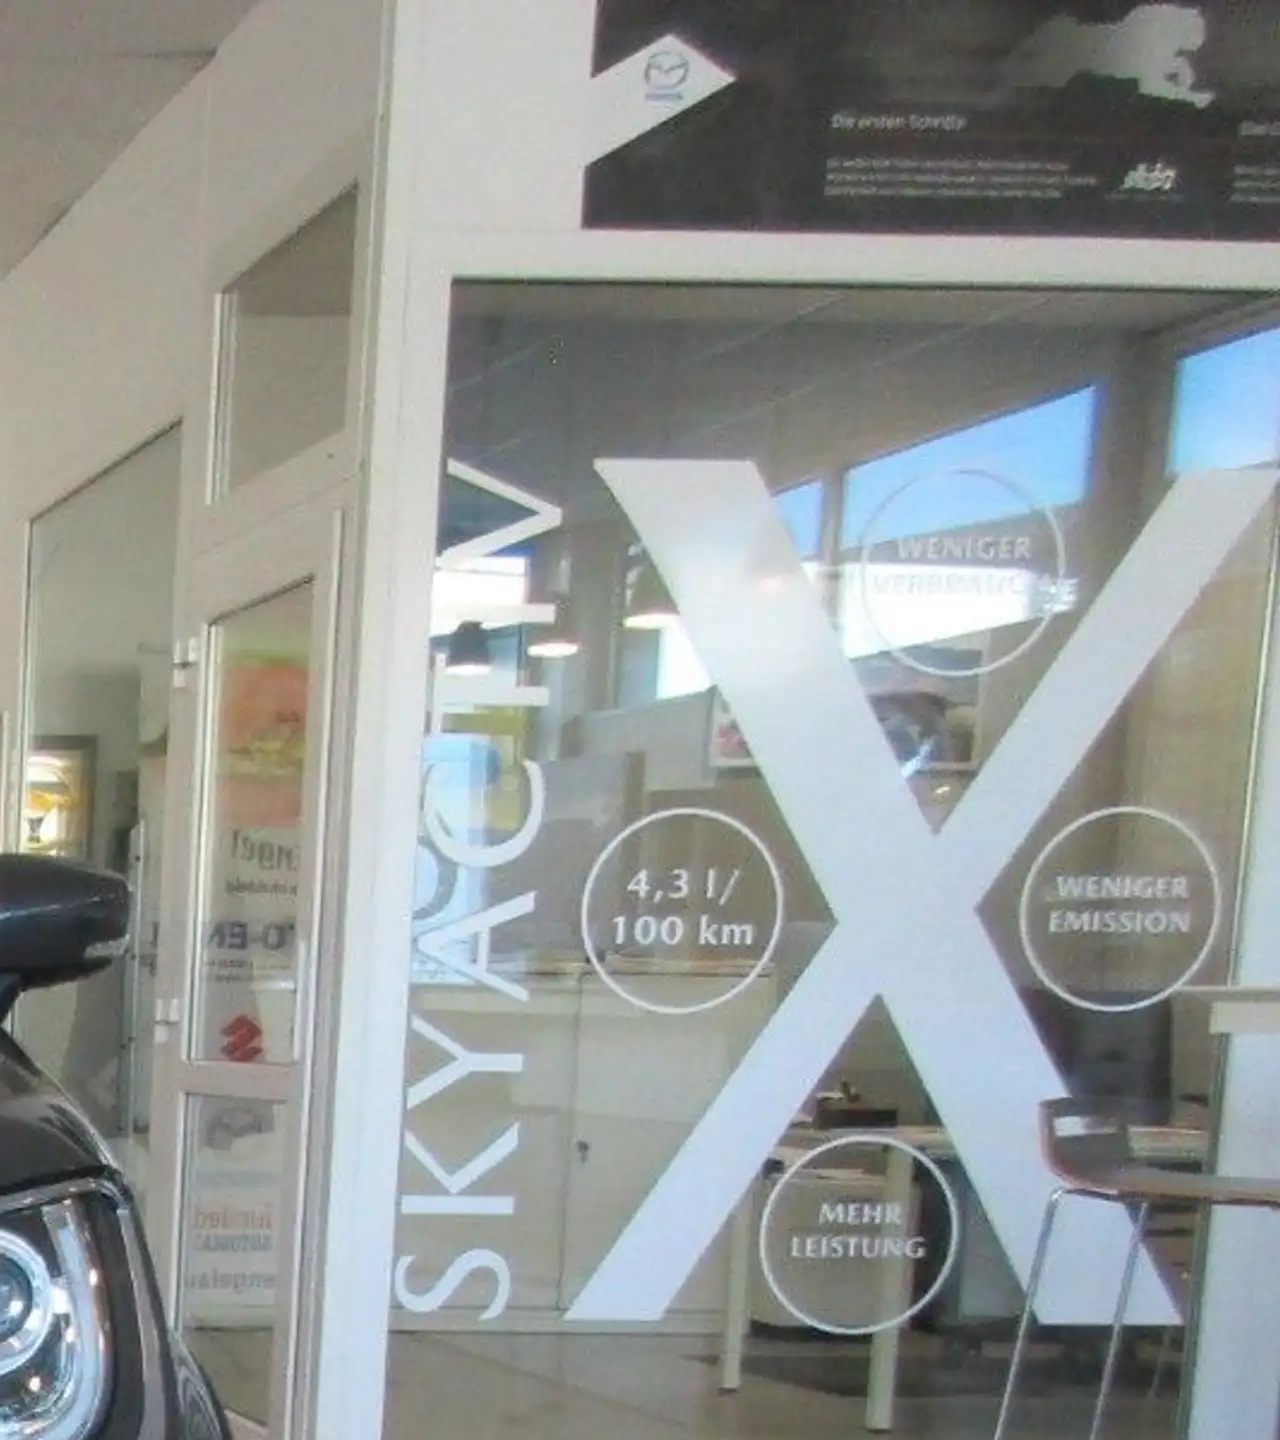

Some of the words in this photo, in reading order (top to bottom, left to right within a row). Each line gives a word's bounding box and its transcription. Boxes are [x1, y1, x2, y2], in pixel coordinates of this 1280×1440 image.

[896, 536, 1032, 560] WENIGER
[872, 571, 1047, 598] VERBRAUC
[393, 457, 562, 1321] SKYACTIV
[627, 868, 689, 904] 4,3
[1056, 875, 1189, 898] WENIGER
[612, 914, 685, 945] 100
[698, 913, 754, 945] km
[1048, 911, 1189, 933] EMISSION
[819, 1203, 901, 1225] MEHR
[790, 1236, 927, 1259] LEISTUNG
